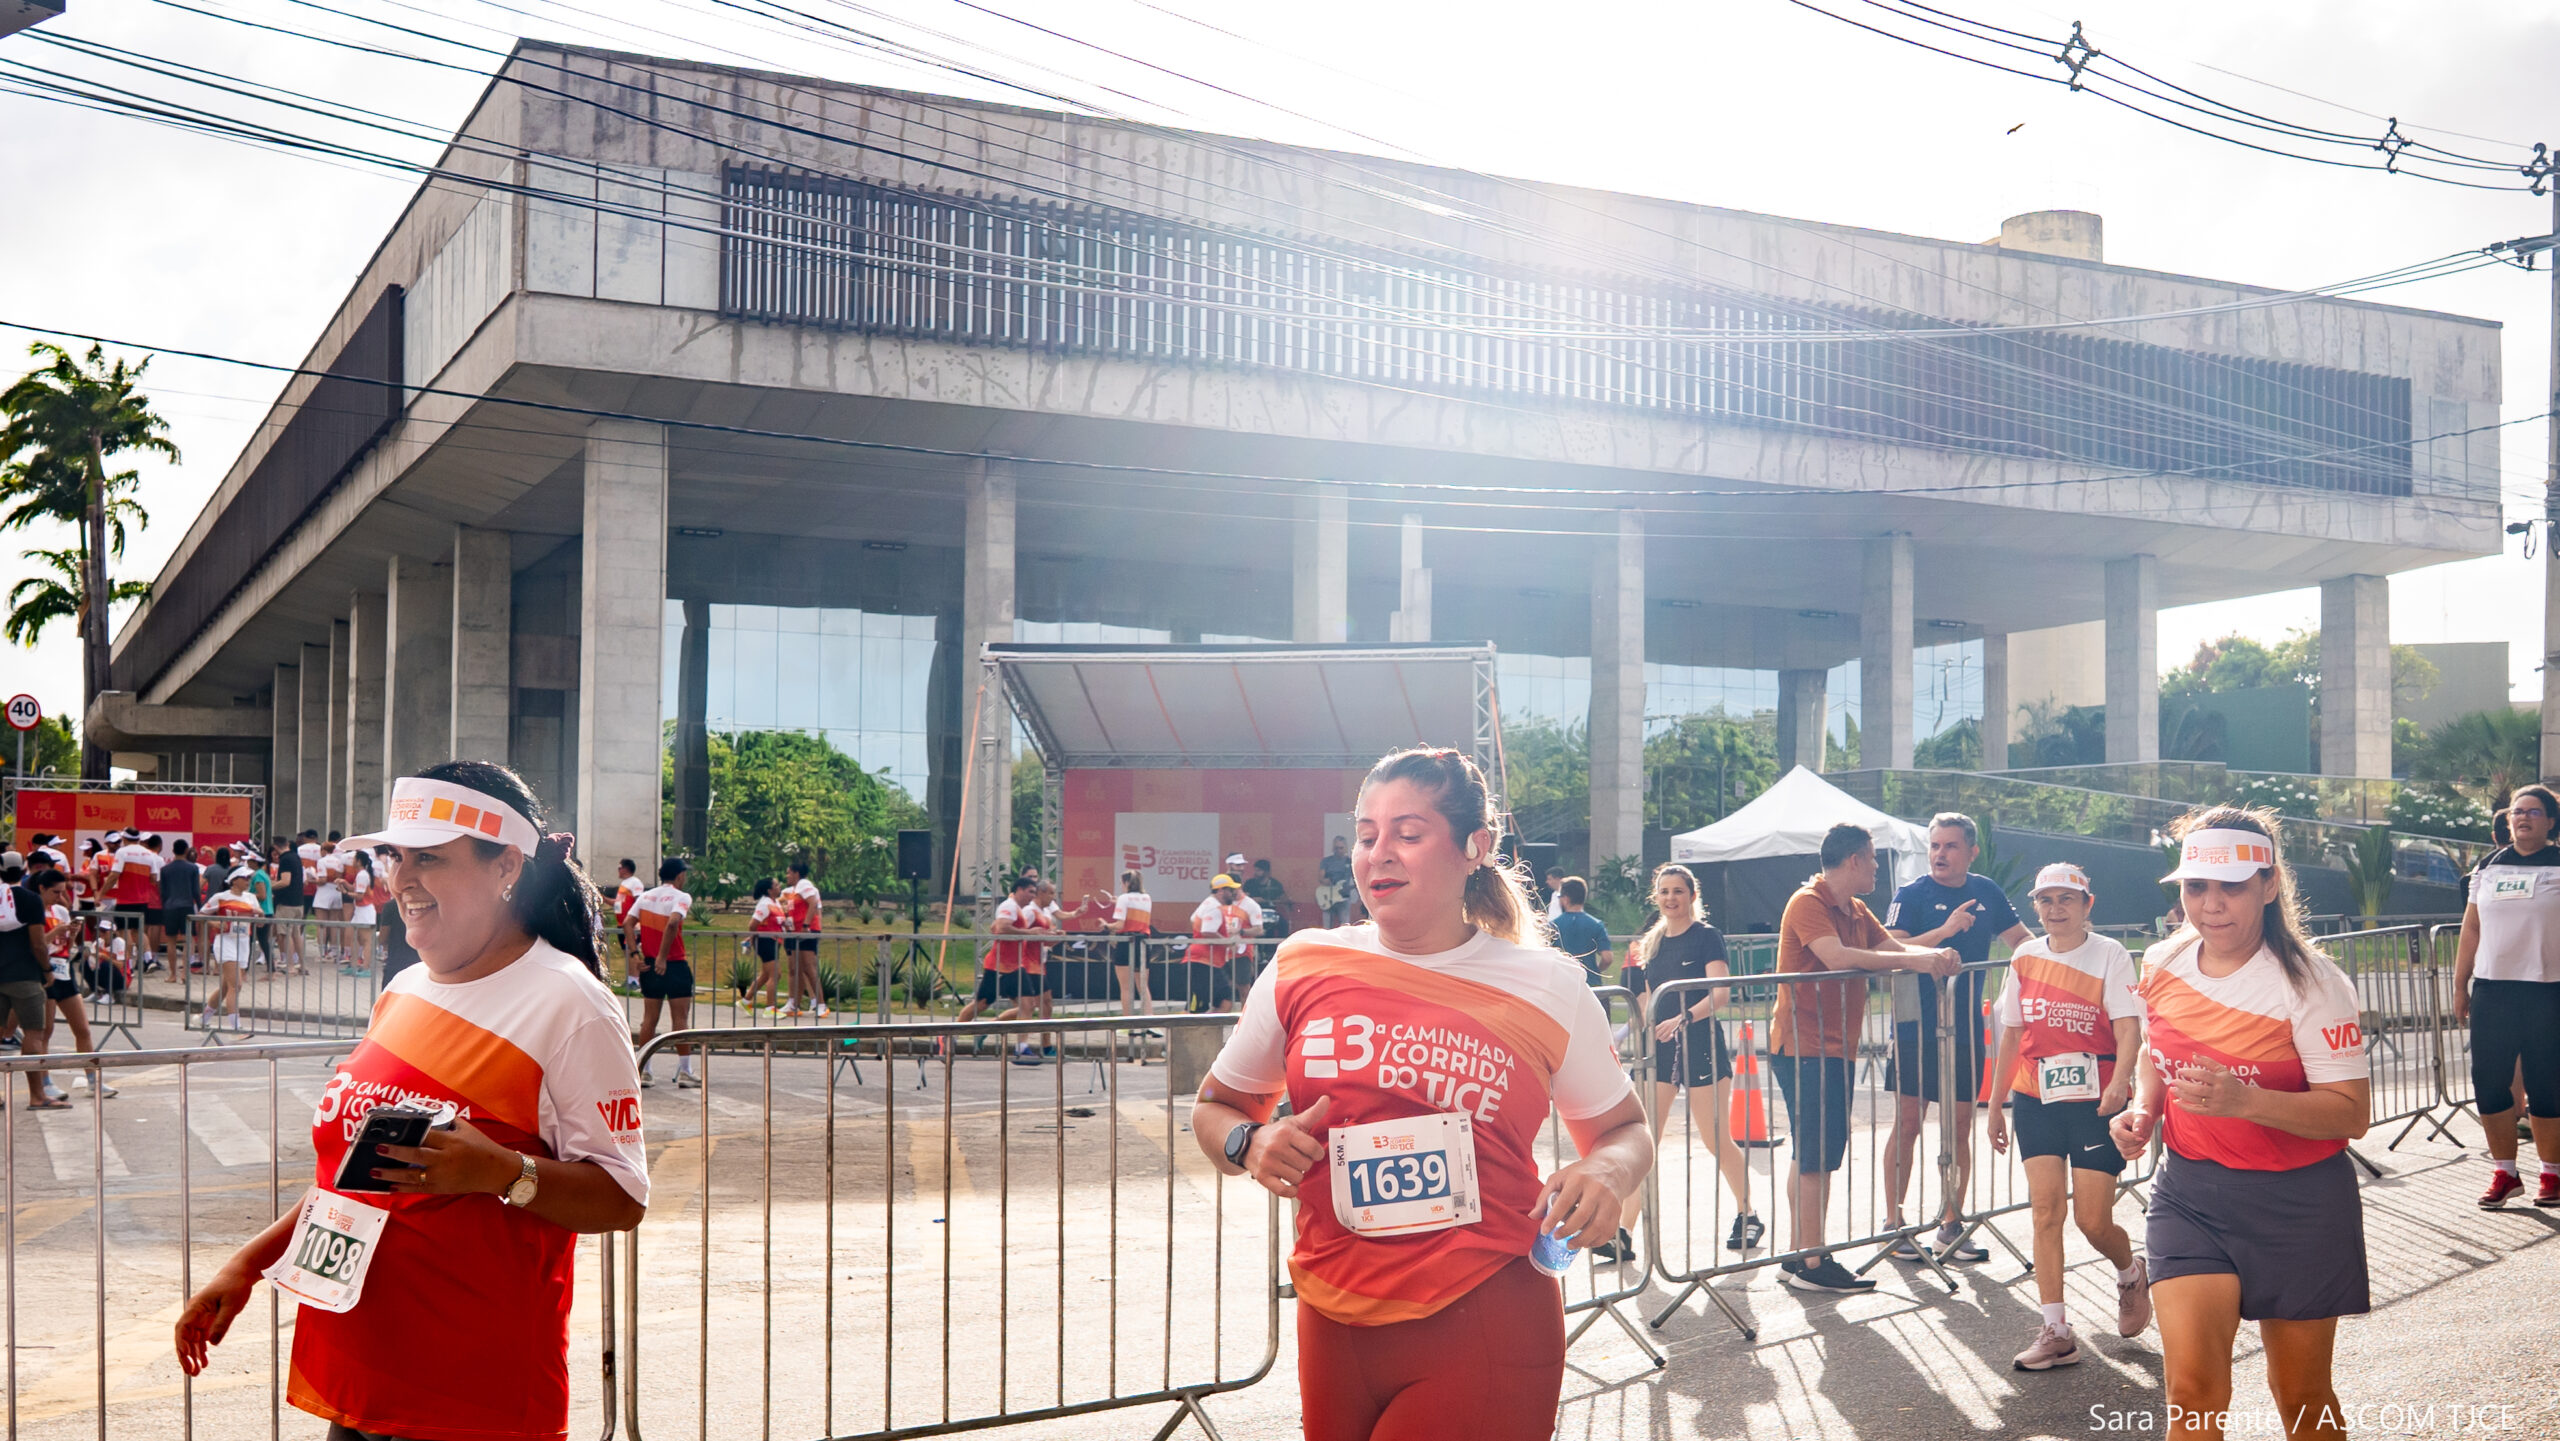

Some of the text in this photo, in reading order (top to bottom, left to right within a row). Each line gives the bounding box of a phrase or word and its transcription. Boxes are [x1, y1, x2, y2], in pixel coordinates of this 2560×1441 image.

[11, 701, 36, 717] 40
[33, 810, 56, 820] TJCE
[210, 815, 234, 827] TJCE
[2209, 856, 2229, 864] TJCE
[1159, 865, 1209, 880] DO TJCE
[2500, 880, 2522, 891] 421
[2047, 1008, 2097, 1021] /CORRIDA
[2051, 1001, 2100, 1014] CAMINHADA
[2047, 1017, 2095, 1035] DO TJCE
[1340, 1015, 1515, 1071] 3ª CAMINHADA
[2321, 1022, 2362, 1050] VID
[1379, 1040, 1509, 1091] /CORRIDA
[2175, 1059, 2260, 1077] CAMADA
[2050, 1068, 2080, 1087] 246
[356, 1081, 471, 1120] CAMINDA
[1378, 1064, 1502, 1123] DO TJCE
[596, 1097, 641, 1132] VID
[343, 1118, 359, 1141] D
[620, 1134, 641, 1146] equi
[1399, 1143, 1415, 1151] TJCE
[1337, 1145, 1345, 1167] 5KM
[1352, 1154, 1447, 1203] 1639
[302, 1227, 363, 1281] 1098
